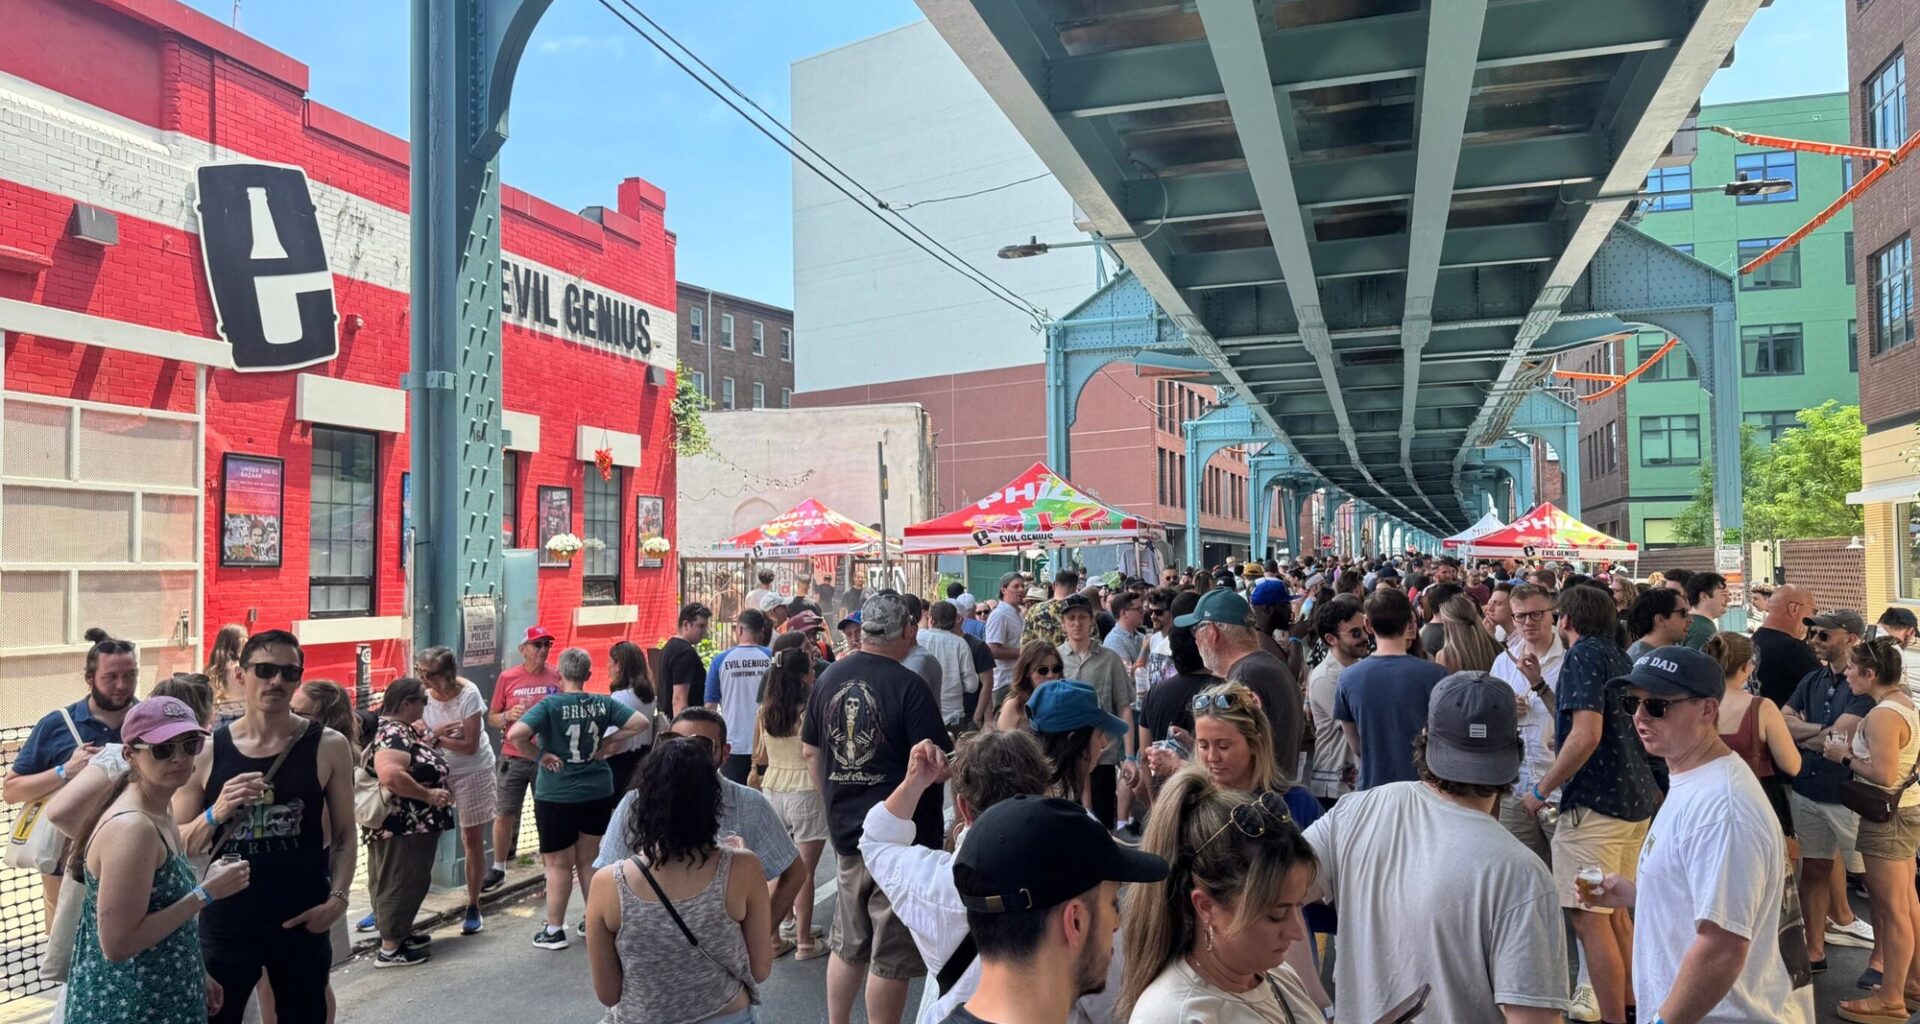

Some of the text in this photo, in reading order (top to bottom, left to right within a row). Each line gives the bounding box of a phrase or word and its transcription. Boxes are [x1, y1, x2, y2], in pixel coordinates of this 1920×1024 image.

[501, 259, 651, 355] EVIL GENIUS
[260, 467, 271, 475] THE
[999, 534, 1019, 543] EVIL
[1020, 532, 1053, 542] GENIUS
[1541, 549, 1555, 557] EVIL
[471, 631, 490, 642] POLICE
[725, 659, 770, 670] EVIL GENIUS
[1649, 657, 1679, 673] DAD
[513, 686, 547, 697] PHILLIES
[562, 702, 606, 720] BROWN
[565, 720, 600, 764] 11
